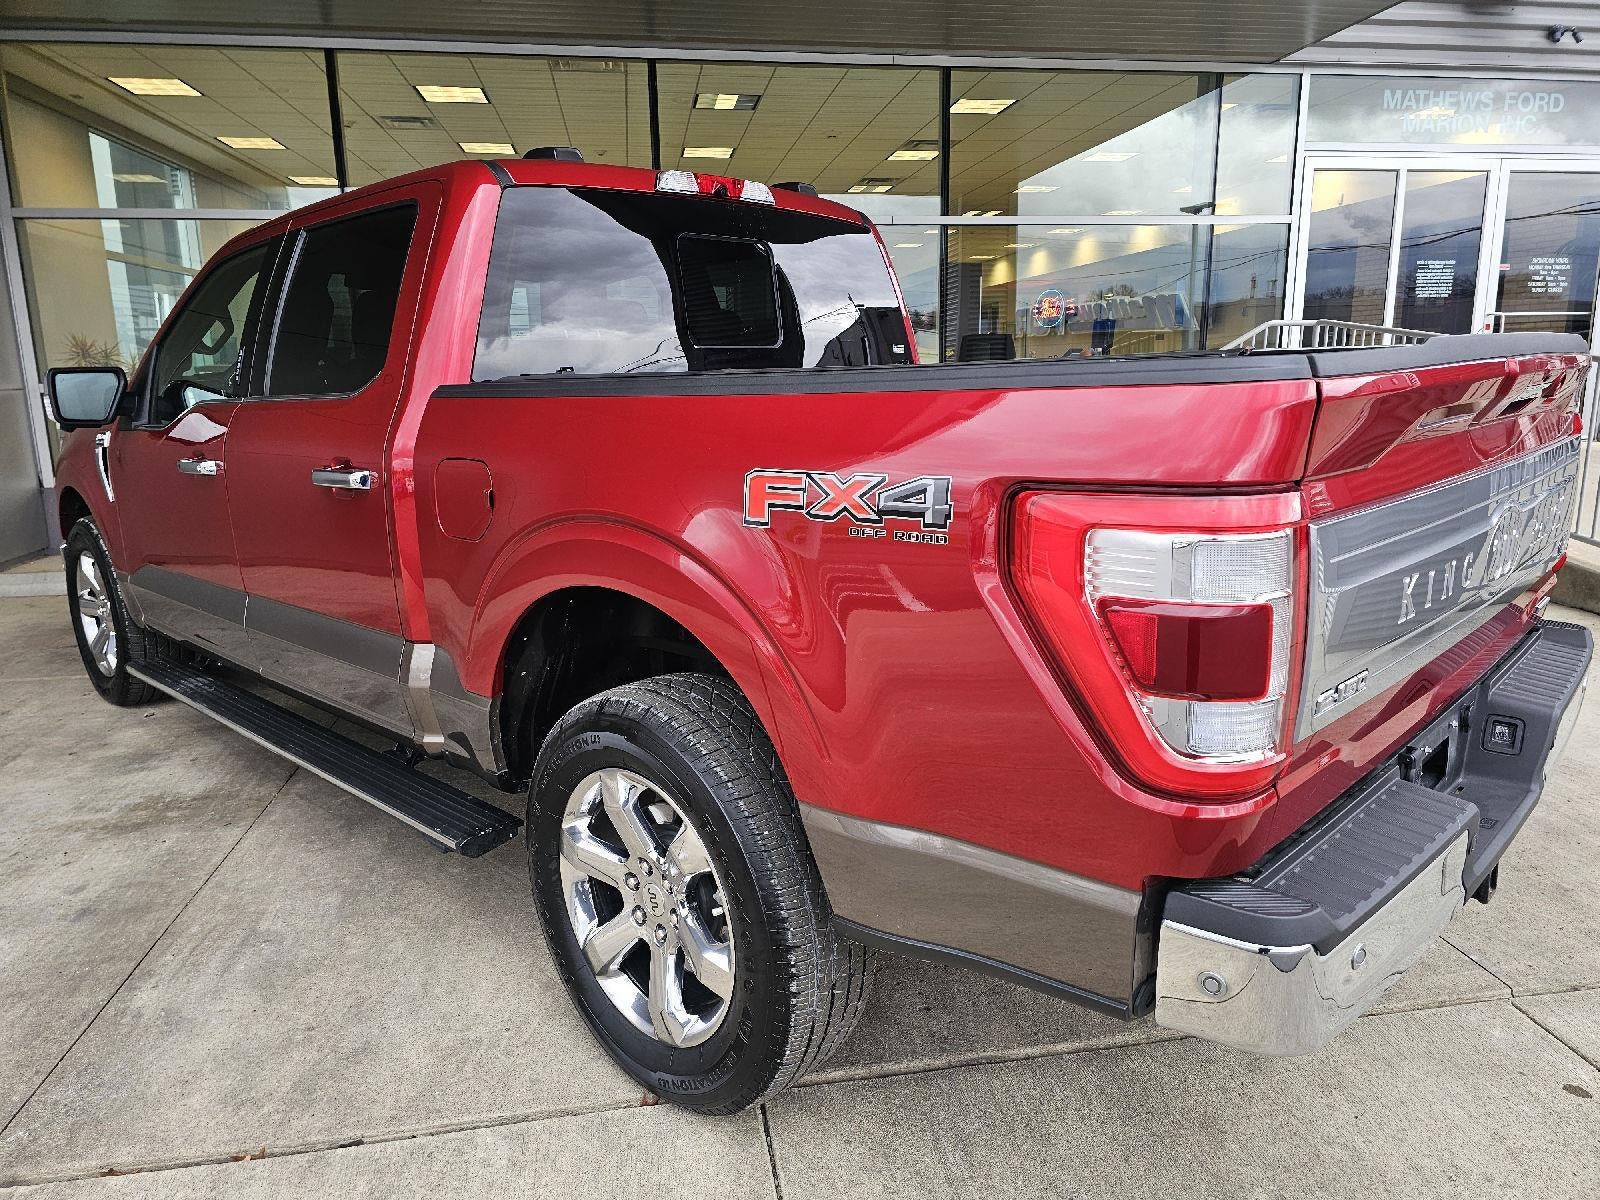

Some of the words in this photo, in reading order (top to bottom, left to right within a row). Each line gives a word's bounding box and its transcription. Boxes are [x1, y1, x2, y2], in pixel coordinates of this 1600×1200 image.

[1383, 89, 1494, 111] MATHEWS
[1503, 93, 1565, 113] FORD
[1402, 114, 1490, 133] MARION
[743, 468, 953, 529] FX4
[848, 527, 887, 538] OFF
[893, 531, 949, 545] ROAD
[1397, 551, 1474, 625] KING
